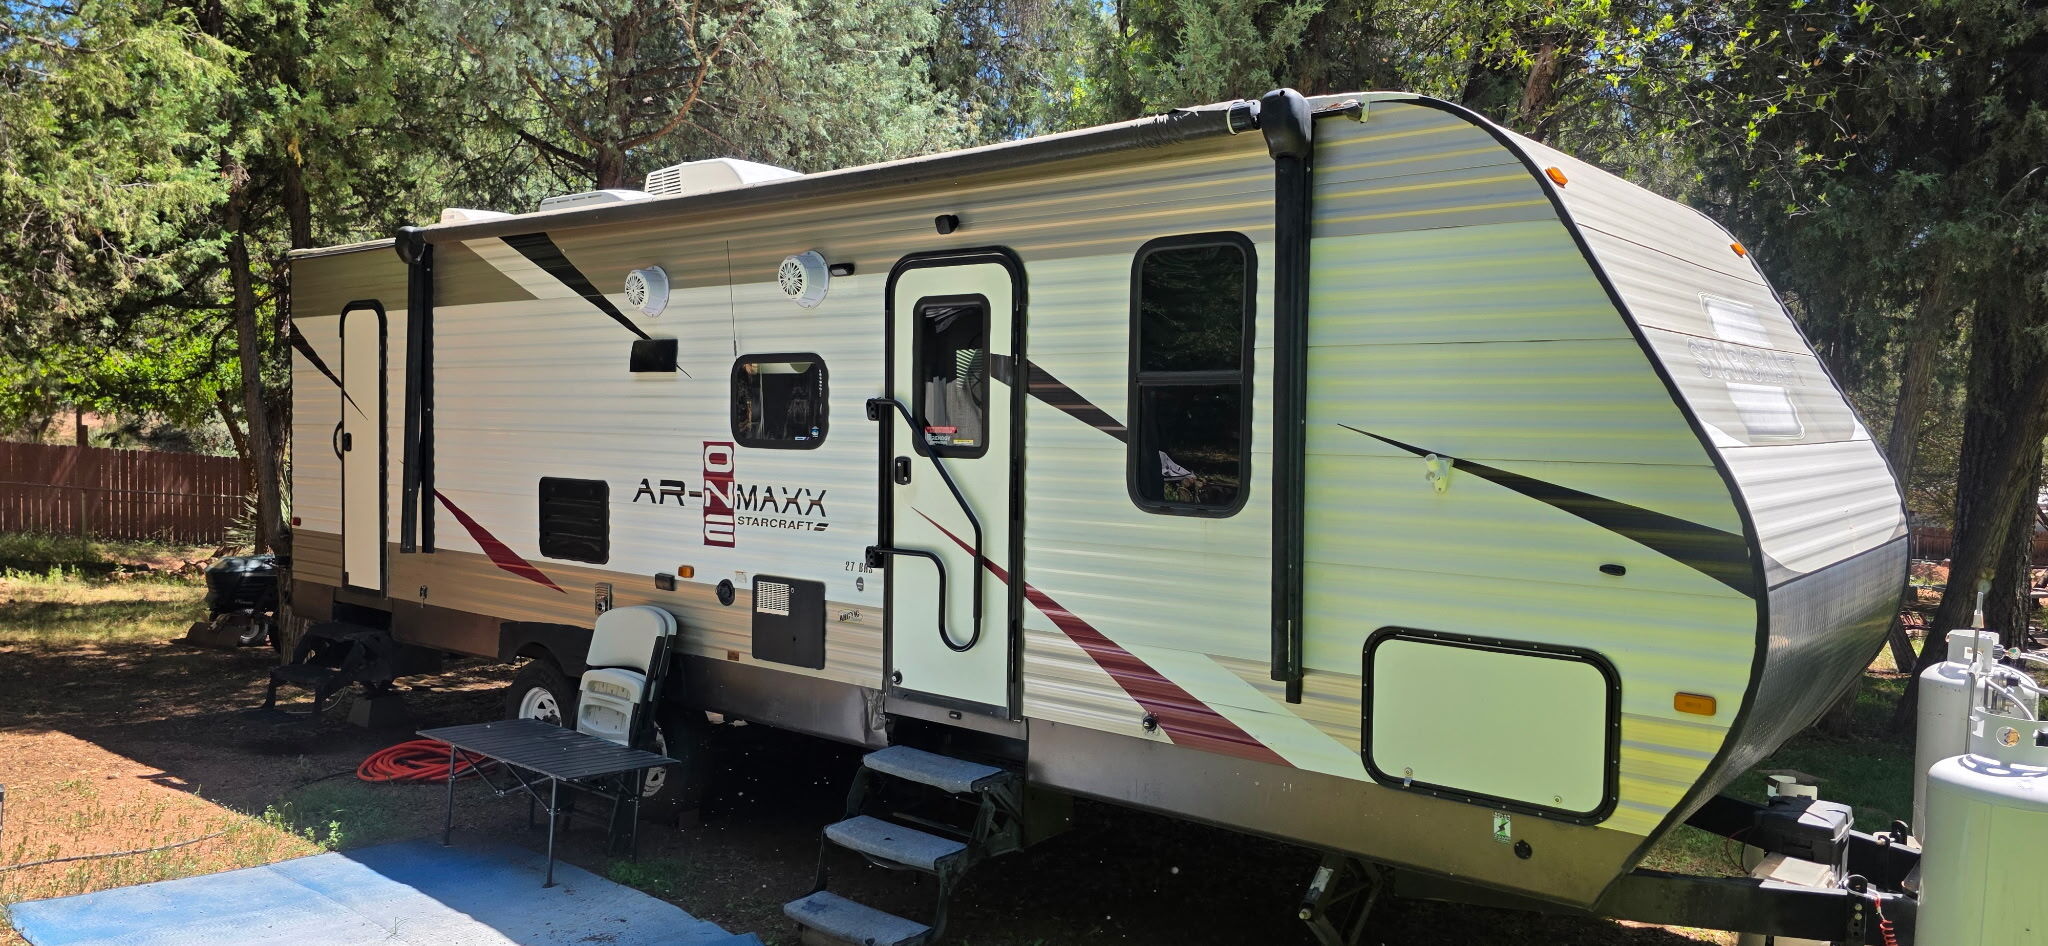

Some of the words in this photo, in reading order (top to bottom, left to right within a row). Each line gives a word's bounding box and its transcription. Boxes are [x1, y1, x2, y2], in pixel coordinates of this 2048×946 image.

[736, 483, 827, 517] MAXX
[737, 515, 814, 532] STARCRAFT
[845, 561, 855, 572] 27
